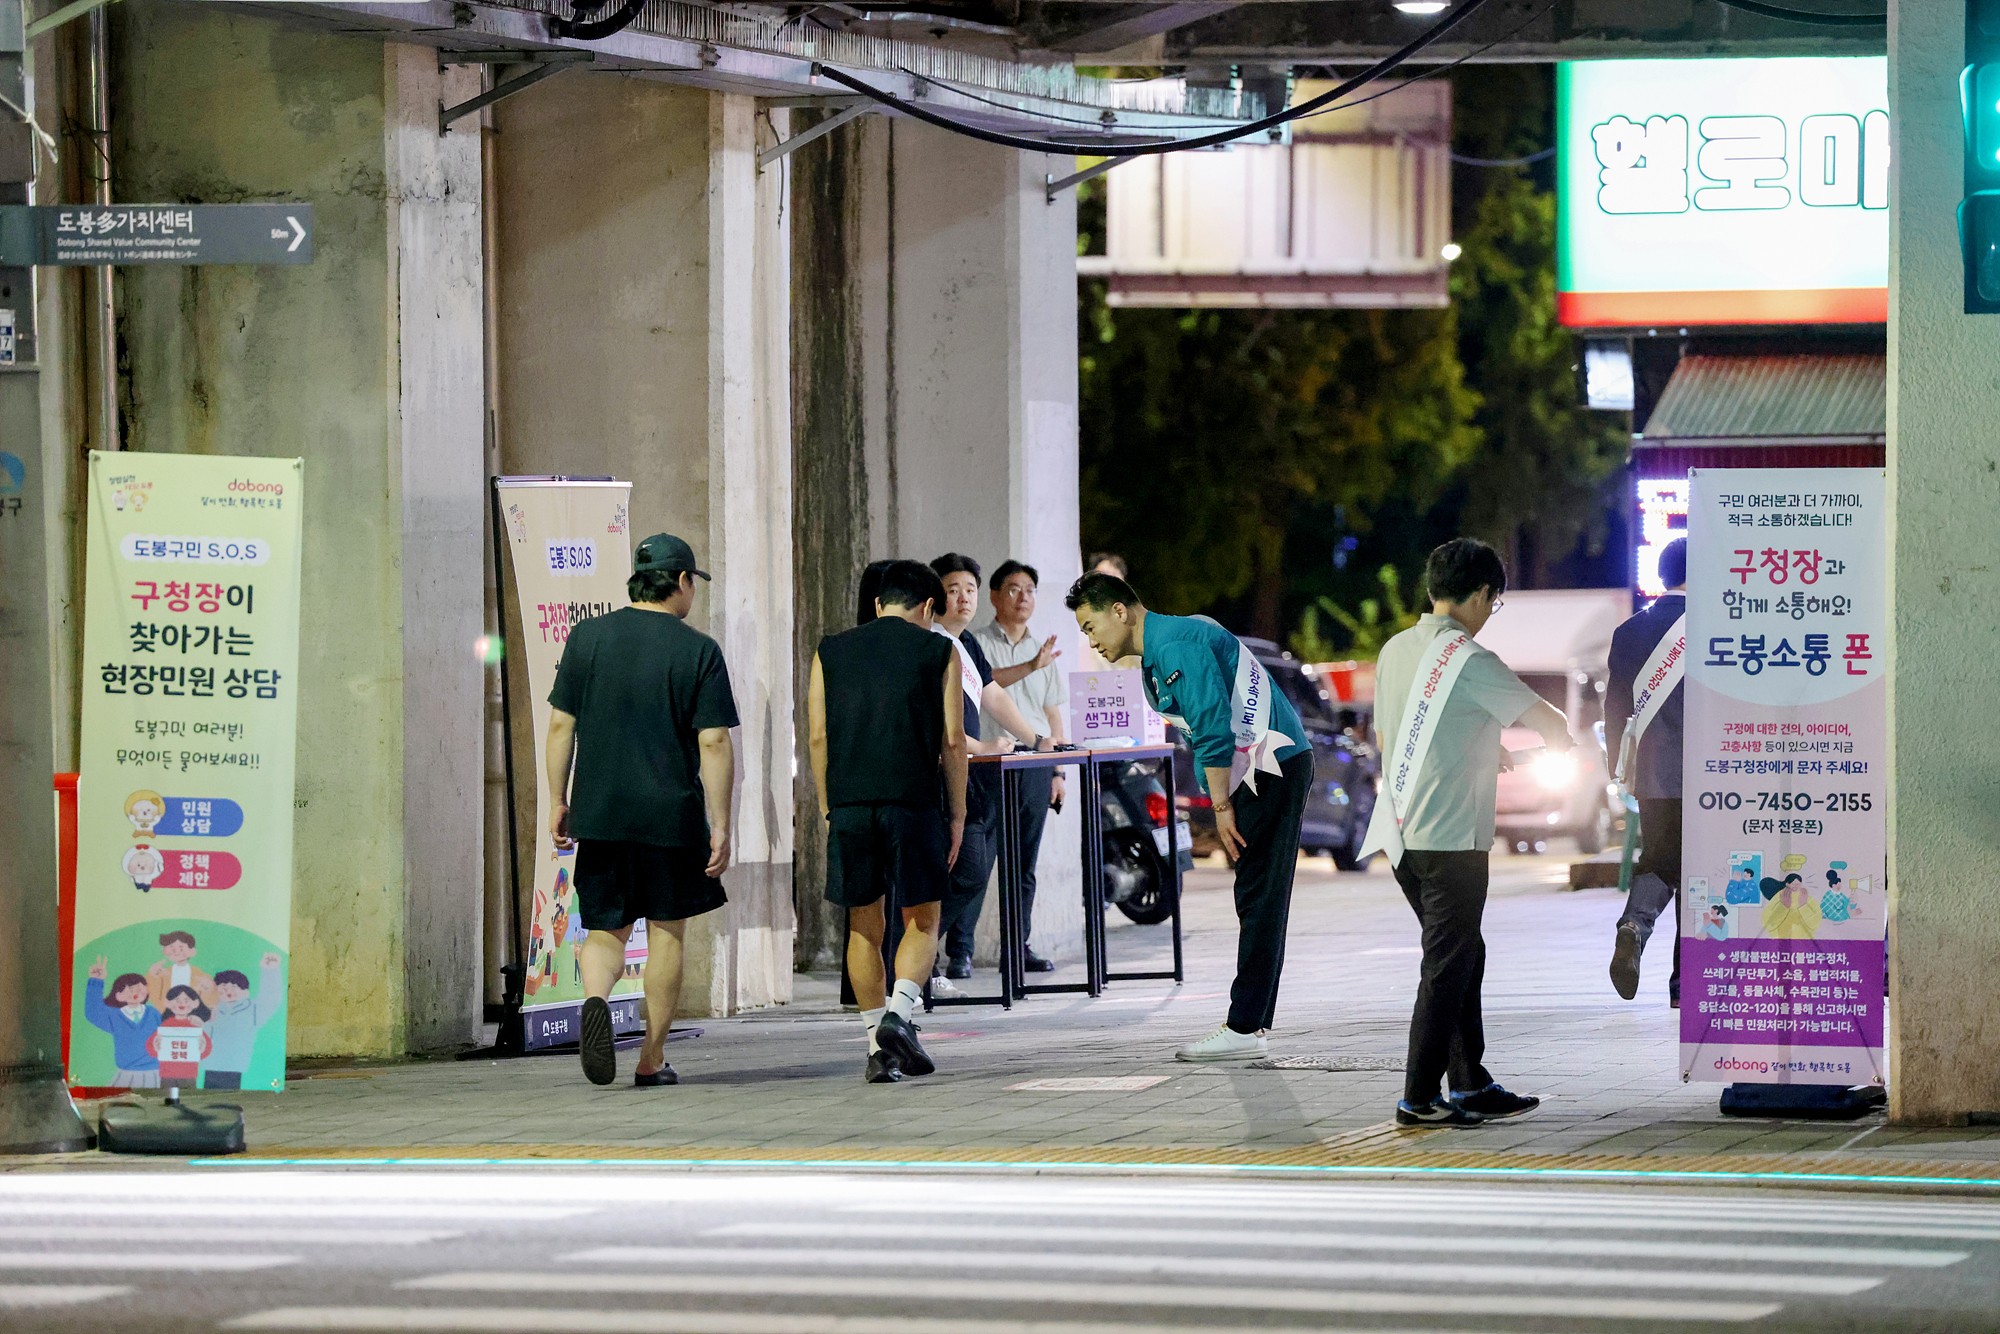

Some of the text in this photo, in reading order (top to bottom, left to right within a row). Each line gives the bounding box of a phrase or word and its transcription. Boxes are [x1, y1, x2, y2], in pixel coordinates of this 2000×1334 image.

[57, 210, 193, 234] 도봉多가치센터
[57, 237, 201, 248] Dobong Shared Value Community Center
[228, 478, 283, 495] dobong
[1718, 493, 1863, 509] 구민 여러분과 더 가까이,
[1727, 512, 1852, 527] 적극 소통하겠습니다!
[134, 540, 257, 560] 도봉구민 S.O.S
[569, 546, 592, 569] S.O.S
[1729, 547, 1846, 585] 구청장과
[132, 580, 254, 615] 구청장이
[1722, 588, 1852, 621] 함께 소통해요!
[130, 621, 255, 656] 찾아가는
[1704, 633, 1873, 677] 도봉소통 폰
[101, 662, 282, 700] 현장민원 상담
[1088, 697, 1125, 708] 도봉구민
[1085, 711, 1130, 729] 생각함
[1395, 634, 1469, 793] 도봉구청장 현장민원 상담
[134, 720, 244, 743] 도봉구민 여러분!
[1723, 723, 1852, 737] 구정에 대한 건의, 아이디어,
[1720, 740, 1854, 754] 고충사항 등이 있으시면 지금
[116, 749, 260, 772] 무엇이든 물어보세요!!
[1704, 759, 1868, 775] 도봉구청장에게 문자 주세요!
[181, 800, 212, 817] 민원
[1698, 791, 1873, 812] 010-7450-2155
[181, 819, 211, 834] 상담
[1742, 818, 1824, 836] (문자 전용폰)
[179, 854, 210, 870] 정책
[178, 871, 210, 888] 제안
[1729, 951, 1850, 966] 생활불편신고(불법주정차,
[1703, 967, 1863, 984] 쓰레기 무단투기, 소음, 불법적치물,
[1707, 984, 1859, 1000] 광고물, 동물사체, 수목관리 등)는
[611, 1009, 624, 1025] 봉구청
[1698, 1001, 1867, 1016] 응답소(02-120)을 통해 신고하시면
[550, 1019, 568, 1034] 도봉구청
[1710, 1018, 1855, 1033] 더 빠른 민원처리가 가능합니다.
[1714, 1056, 1769, 1074] dobong
[1770, 1061, 1786, 1072] 같이
[1809, 1061, 1835, 1073] 행복한
[1837, 1062, 1851, 1074] 도봉
